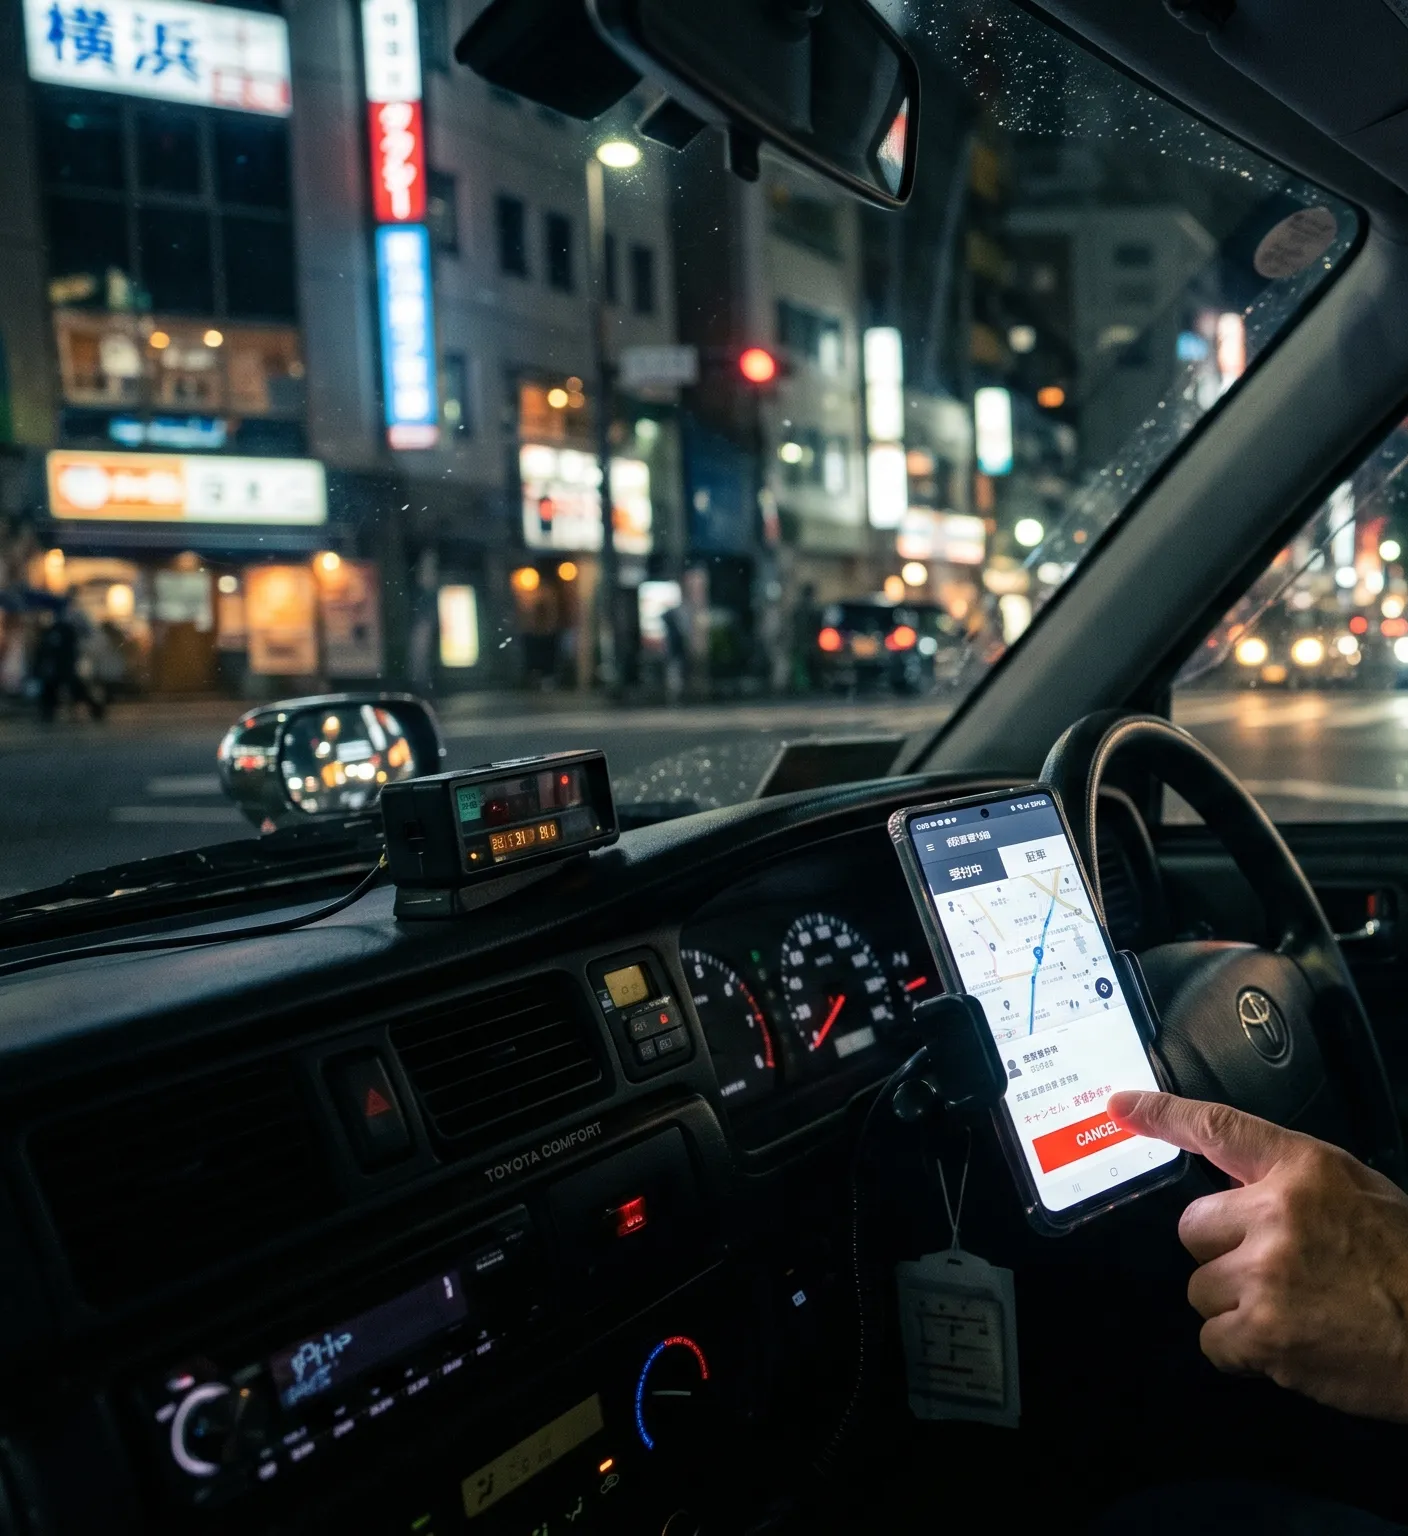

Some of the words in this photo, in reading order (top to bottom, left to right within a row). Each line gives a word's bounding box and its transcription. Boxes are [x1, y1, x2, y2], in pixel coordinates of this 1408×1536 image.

[47, 3, 200, 83] 横浜
[484, 1150, 541, 1183] TOYOTA
[542, 1121, 603, 1158] COMFORT
[1076, 1120, 1122, 1147] CANCEL
